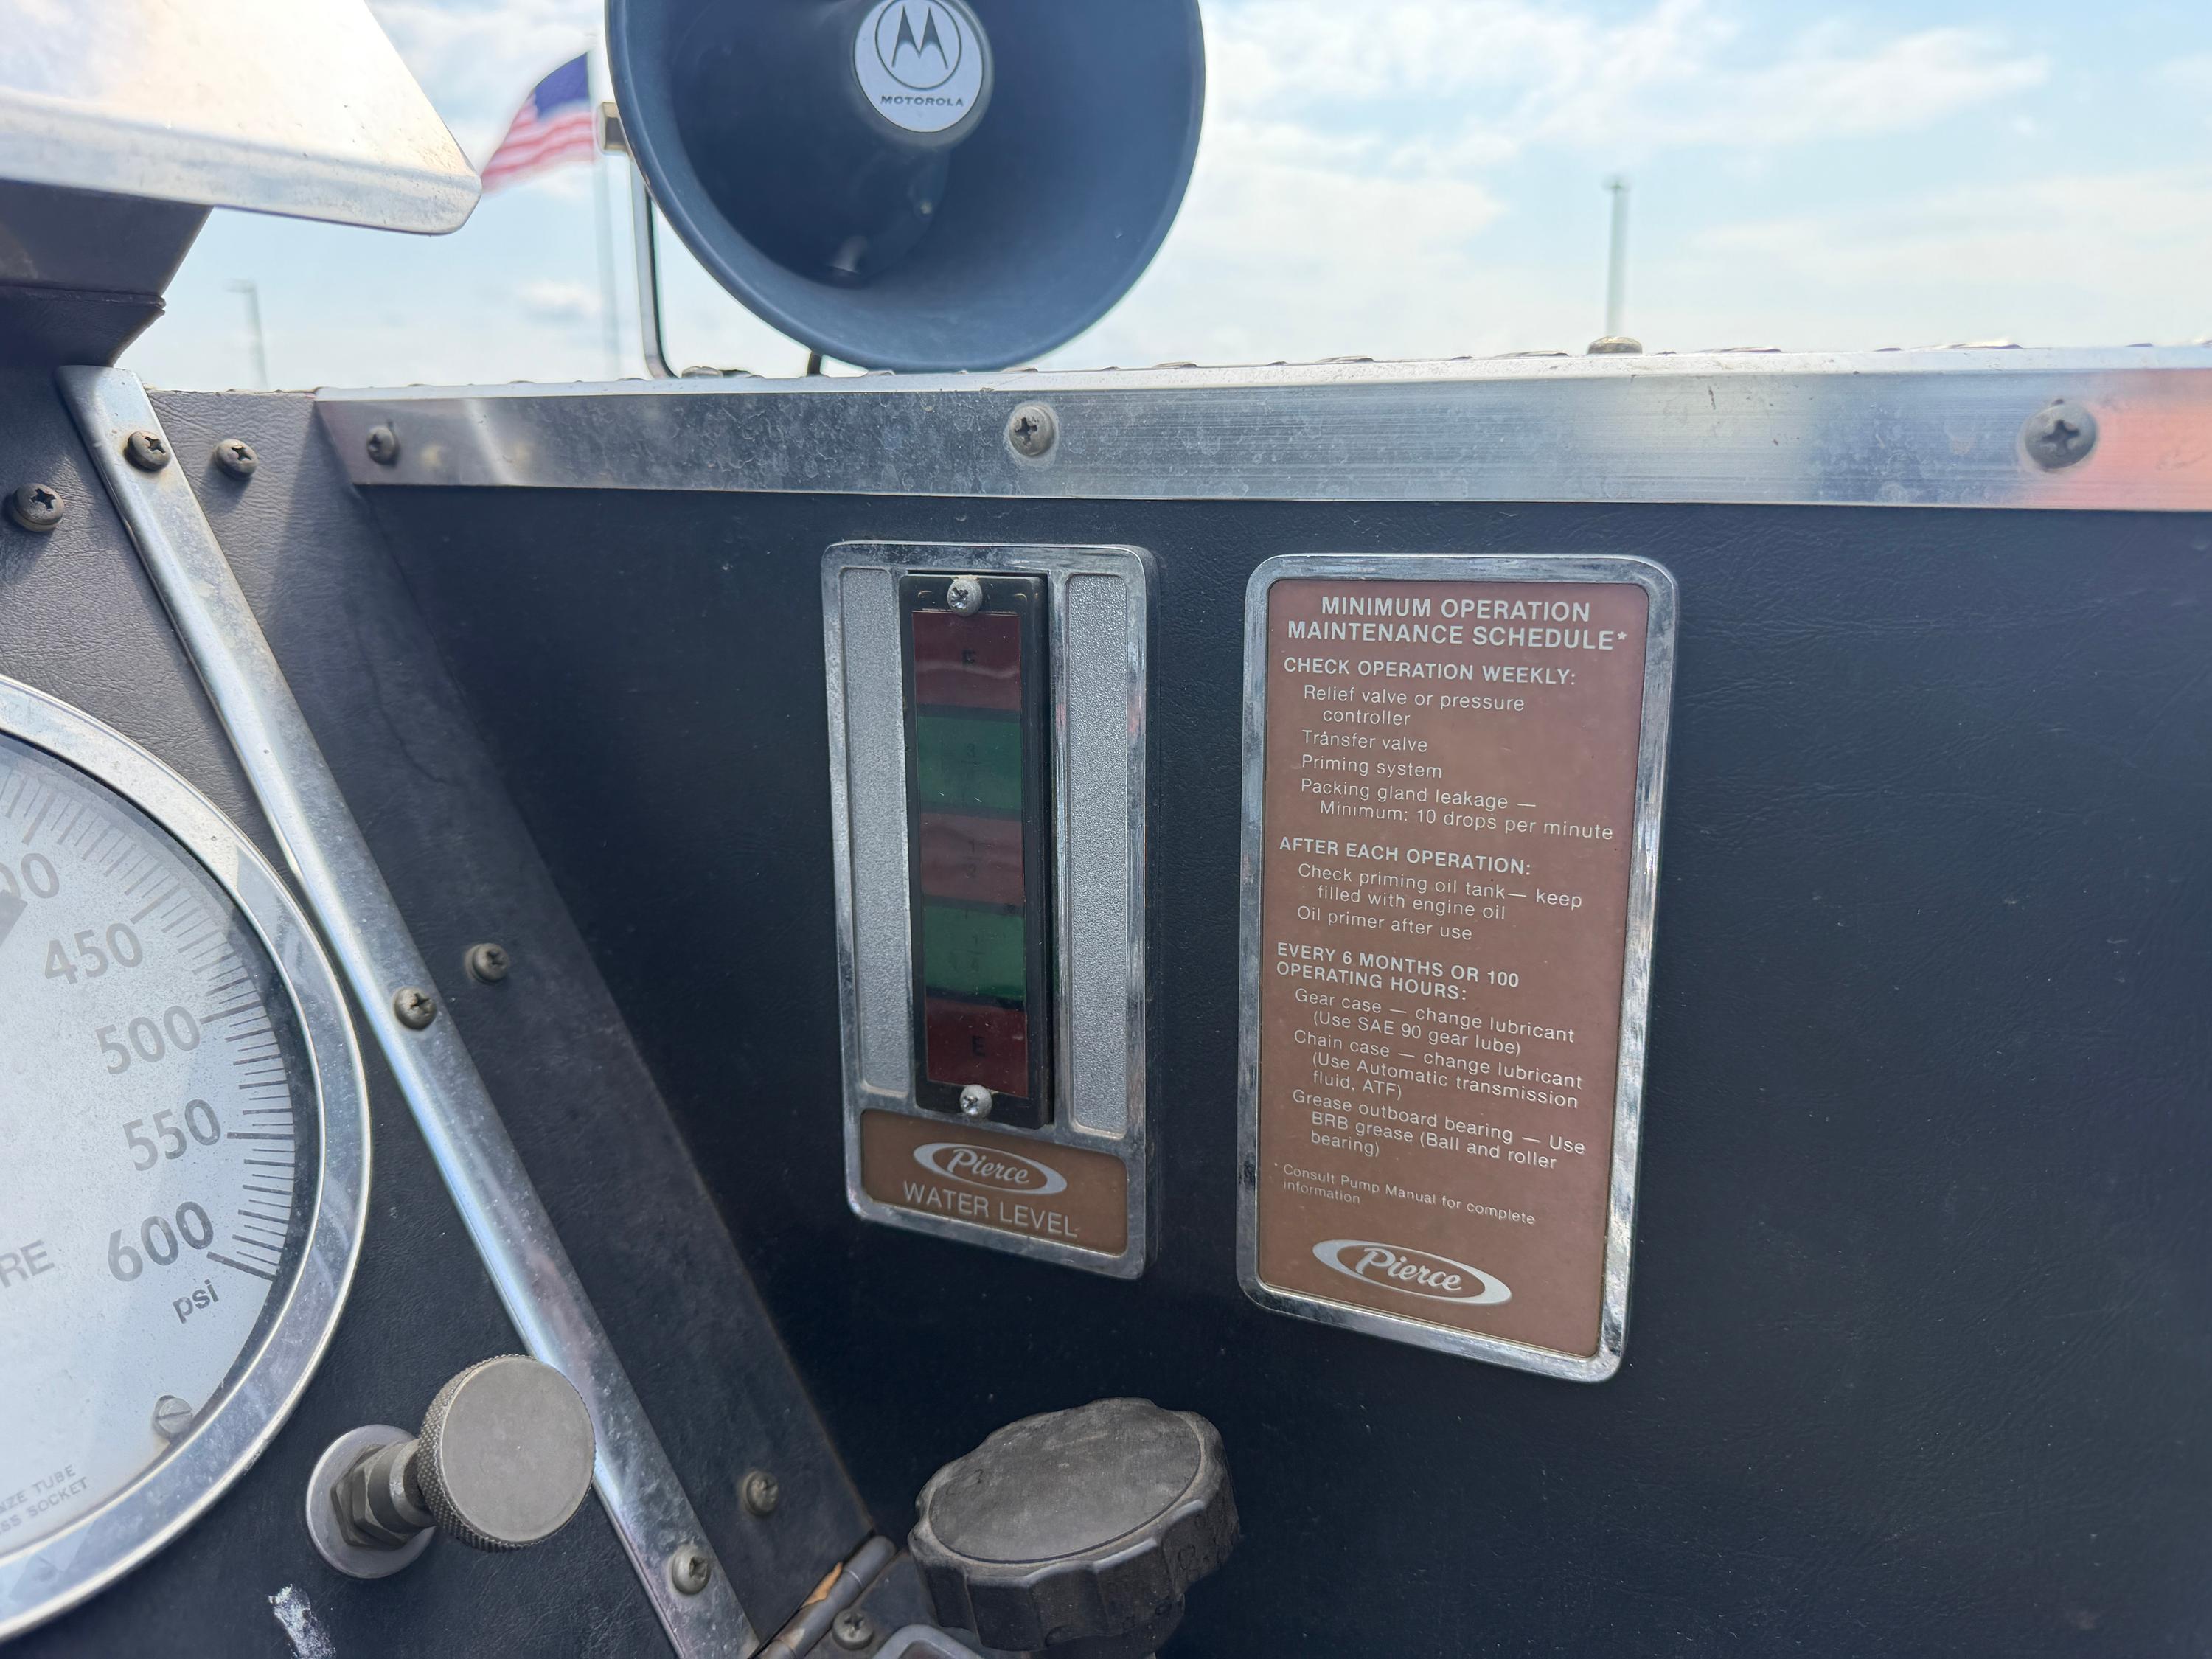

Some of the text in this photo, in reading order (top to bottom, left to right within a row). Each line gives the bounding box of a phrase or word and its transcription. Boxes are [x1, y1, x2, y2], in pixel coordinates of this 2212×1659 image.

[880, 95, 964, 108] MOTOROLA
[1321, 596, 1590, 622] MINIMUM OPERATION
[1288, 620, 1464, 644] MAINTENANCE
[1284, 657, 1576, 685] CHECK OPERATION WEEKLY:
[1304, 684, 1525, 712] Relief valve or pressure
[1323, 709, 1411, 726] controller
[1301, 729, 1427, 753] Transfer valve
[1302, 754, 1442, 779] Priming system
[1301, 778, 1369, 801] Packing
[1377, 785, 1427, 803] gland
[1436, 789, 1508, 812] leakage
[1321, 799, 1613, 840] Minimum: 10 drops per minute
[1279, 836, 1531, 875] AFTER EACH OPERATION:
[1298, 863, 1352, 882] Check
[1360, 871, 1427, 894] priming
[1435, 880, 1457, 894] oil
[1536, 888, 1582, 911] keep
[1318, 884, 1505, 919] filled with engine oil
[1297, 905, 1472, 941] Oil primer after use
[44, 922, 143, 984] 450
[1277, 942, 1519, 988] EVERY 6 MONTHS OR 100
[1276, 961, 1467, 1001] OPERATING HOURS:
[1295, 987, 1335, 1006] Gear
[1341, 998, 1382, 1014] case
[1415, 1007, 1482, 1030] change
[1490, 1016, 1574, 1043] lubricant
[1313, 1010, 1520, 1057] (Use SAE 90 gear lube)
[95, 1005, 201, 1075] 500
[972, 1034, 987, 1057] E
[1294, 1029, 1343, 1050] Chain
[1349, 1041, 1390, 1057] case
[1423, 1051, 1490, 1076] change
[1498, 1062, 1582, 1090] lubricant
[1312, 1051, 1578, 1108] (Use Automatic transmission
[1312, 1070, 1402, 1101] fluid, ATF)
[122, 1099, 221, 1171] 550
[1293, 1089, 1352, 1112] Grease
[1358, 1104, 1437, 1127] outboard
[1444, 1116, 1513, 1144] bearing
[1549, 1134, 1585, 1155] Use
[1312, 1110, 1557, 1169] BRB grease (Ball and roller
[1311, 1129, 1380, 1157] bearing)
[947, 1147, 1030, 1186] Pierce
[903, 1180, 1078, 1238] WATER LEVEL
[1283, 1164, 1535, 1225] Consult Pump Manual for complete
[1284, 1180, 1360, 1204] information
[108, 1201, 214, 1282] 600
[1355, 1246, 1464, 1293] Pierce
[173, 1279, 220, 1324] psi
[27, 1477, 87, 1518] SOCKET
[31, 1464, 76, 1494] TUBE
